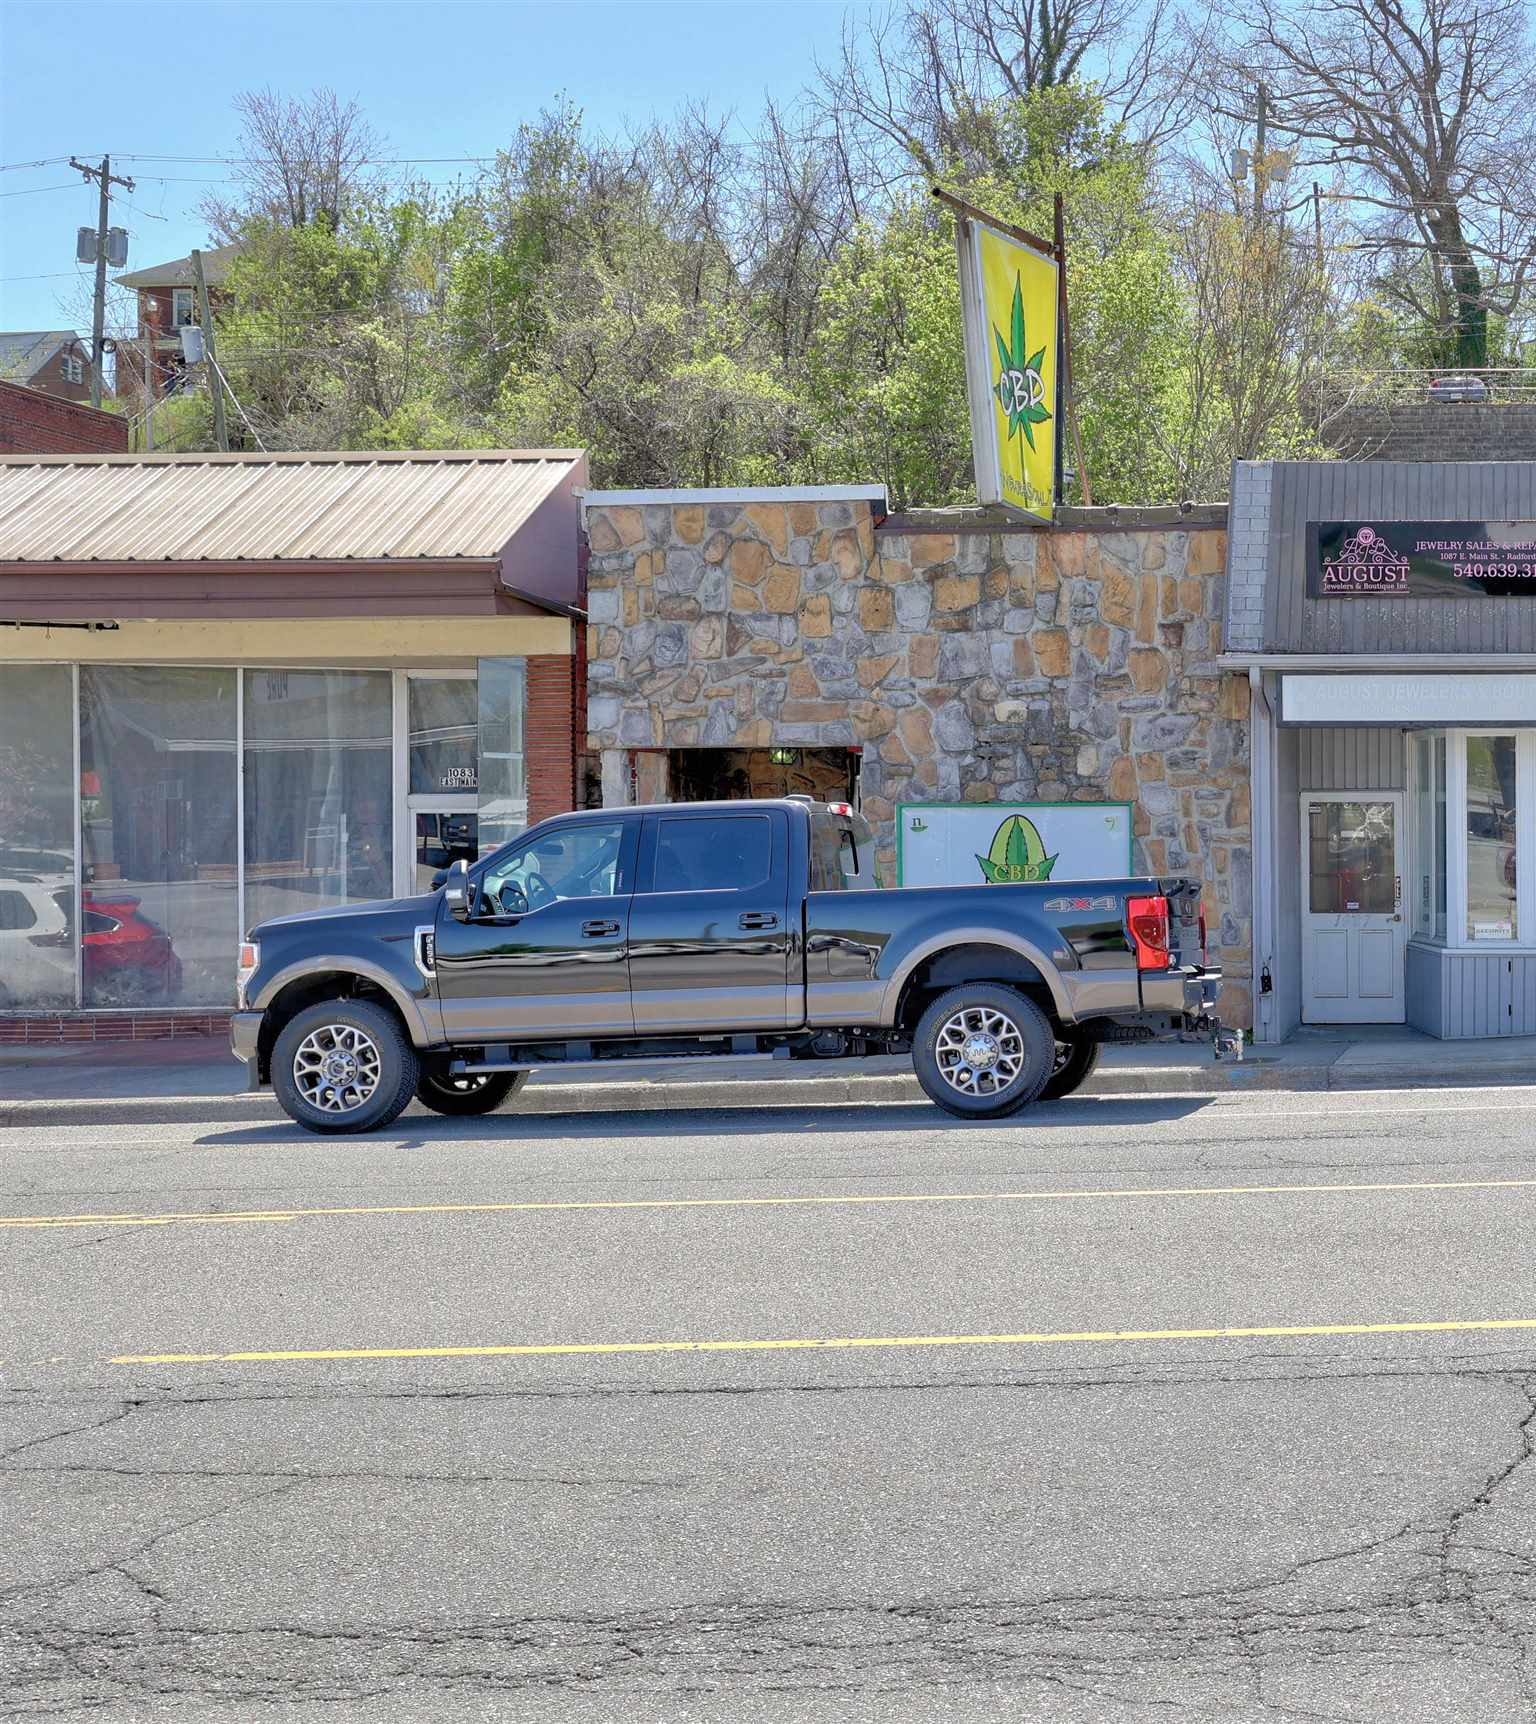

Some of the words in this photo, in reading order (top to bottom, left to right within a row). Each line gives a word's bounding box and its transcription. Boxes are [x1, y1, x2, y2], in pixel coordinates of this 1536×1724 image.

[1000, 368, 1045, 415] CBD
[1414, 541, 1463, 552] JEWELRY
[1466, 541, 1499, 550] SALES
[1503, 542, 1510, 550] &
[1323, 566, 1410, 582] AUGUST
[1323, 583, 1354, 591] Jewelers
[1364, 582, 1395, 591] Boutique
[449, 769, 472, 777] 1083
[994, 865, 1039, 880] CBD
